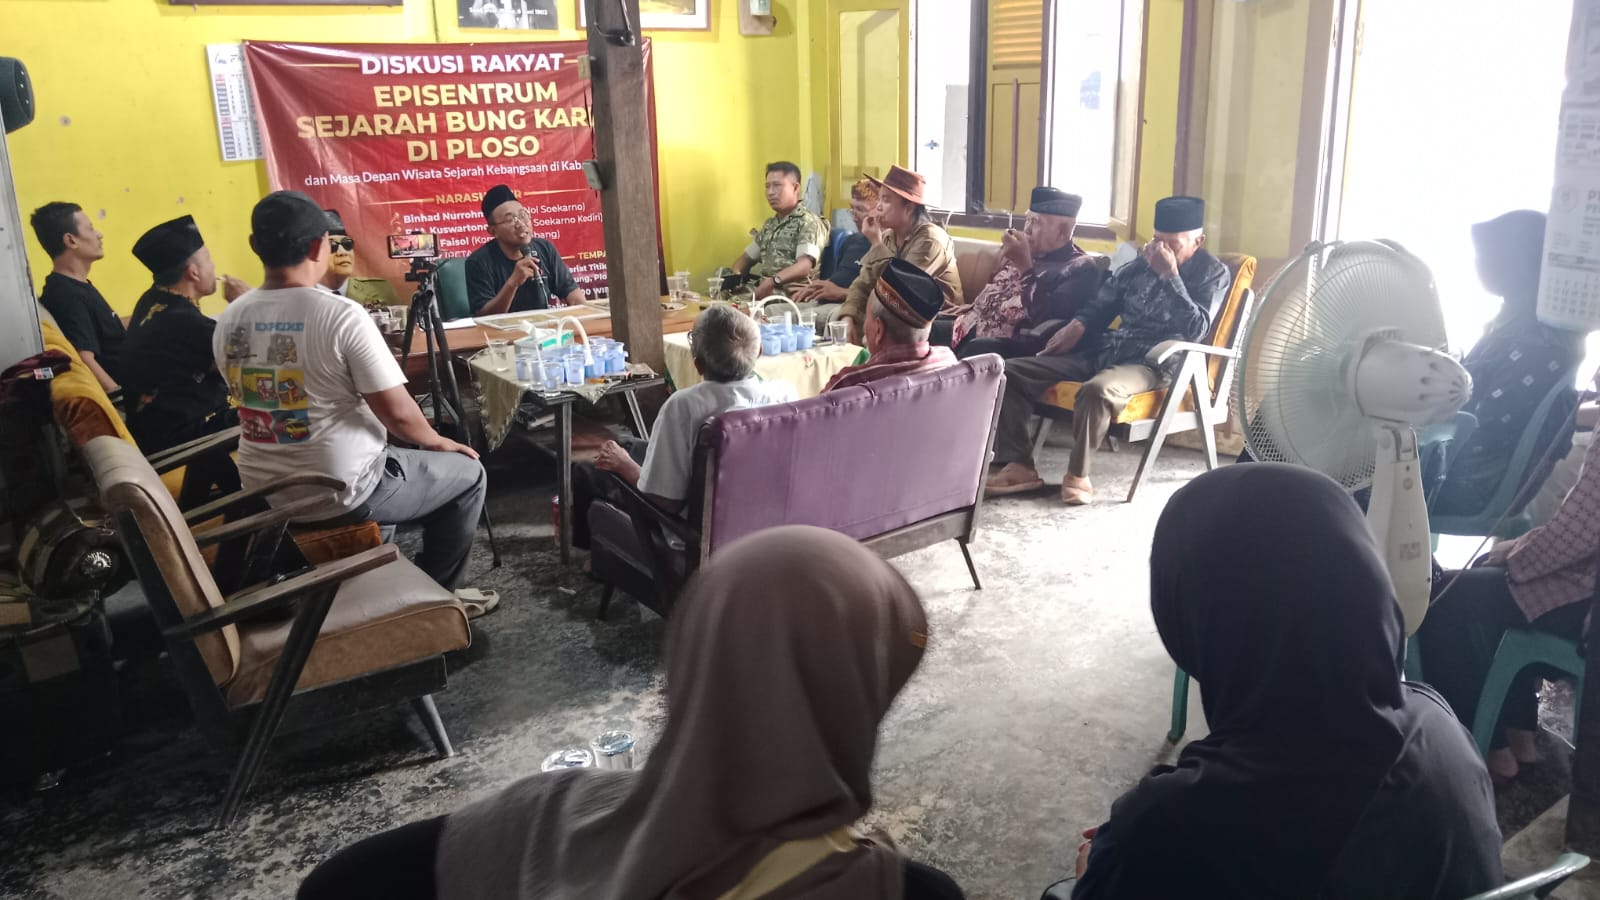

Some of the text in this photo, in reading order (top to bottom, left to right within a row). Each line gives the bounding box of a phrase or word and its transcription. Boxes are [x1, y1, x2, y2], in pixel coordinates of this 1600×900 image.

[361, 52, 565, 75] DISKUSI RAKYAT
[373, 81, 558, 107] EPISENTRUM
[296, 112, 438, 138] SEJARAH
[446, 109, 526, 133] BUNG
[407, 135, 540, 162] DI PLOSO
[304, 174, 328, 186] dan
[330, 173, 361, 185] Masa
[362, 171, 400, 184] Depan
[401, 168, 442, 180] Wisata
[443, 166, 485, 180] Sejarah
[486, 162, 549, 176] Kebangsaan
[550, 161, 560, 172] di
[540, 202, 586, 213] Soekarno)
[403, 212, 440, 224] Binhad
[533, 213, 603, 227] Soekarno Kediri)
[440, 237, 469, 248] Faisol
[594, 271, 608, 281] Plo
